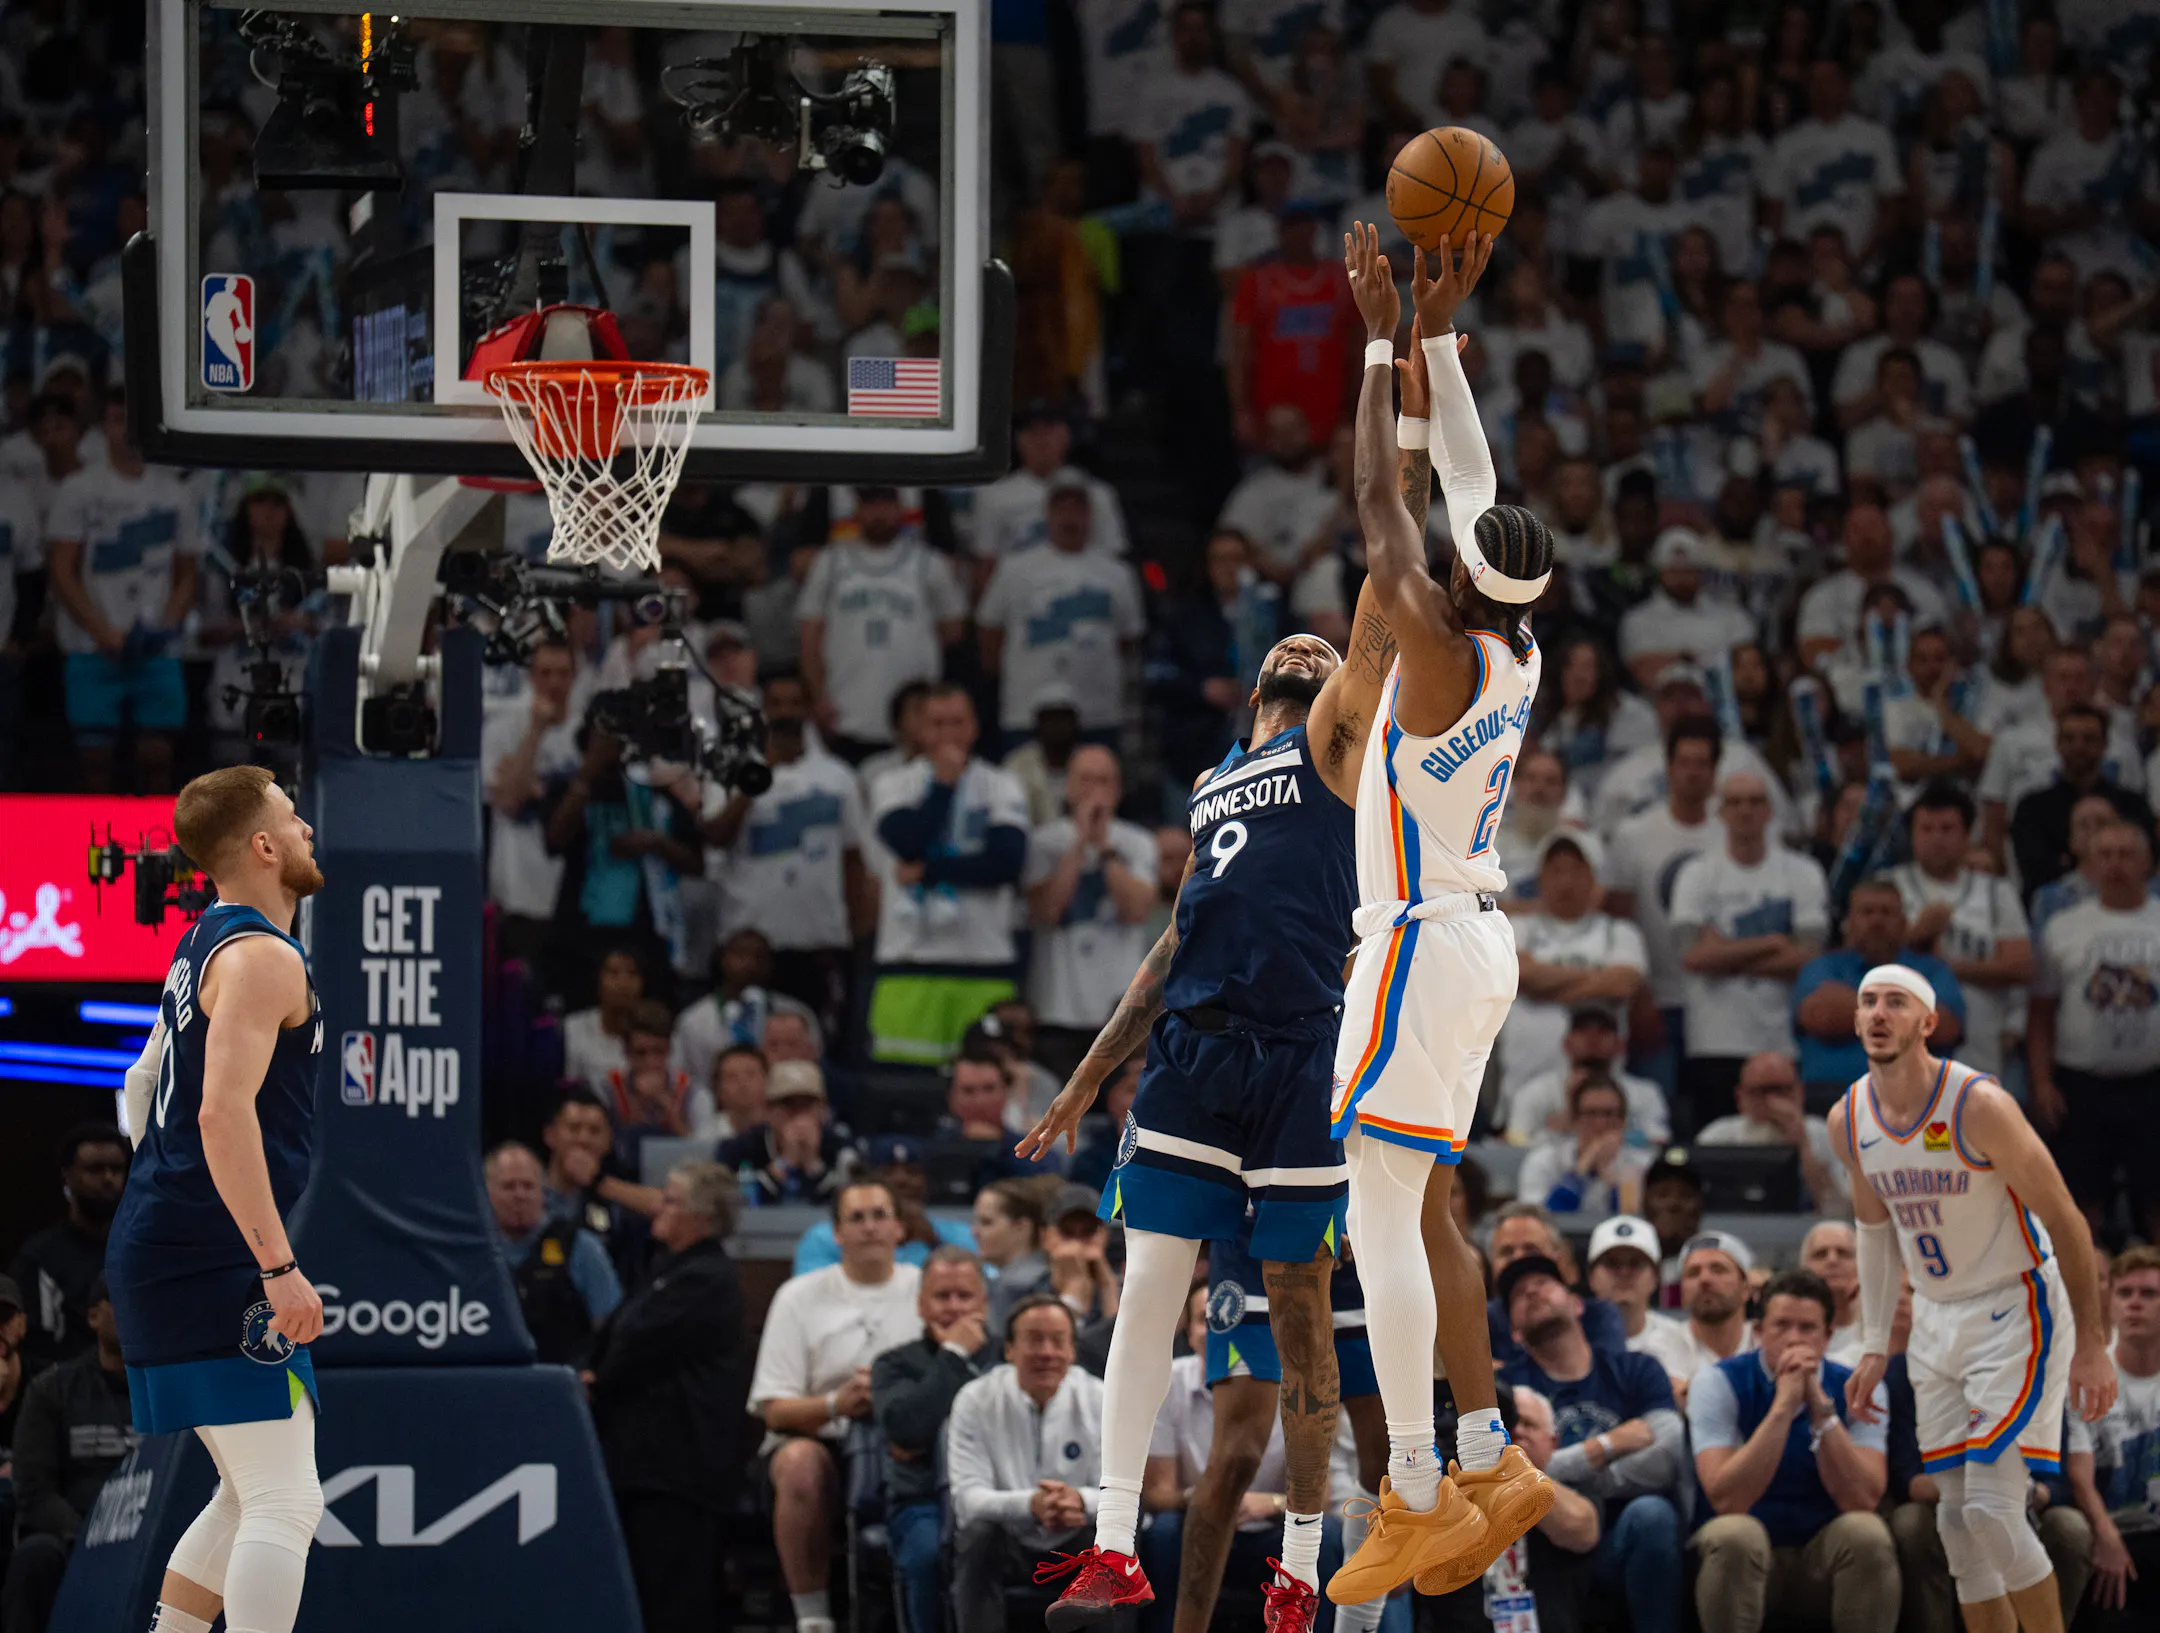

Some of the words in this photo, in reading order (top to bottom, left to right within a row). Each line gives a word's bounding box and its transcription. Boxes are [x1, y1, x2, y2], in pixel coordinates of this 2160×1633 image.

[208, 363, 235, 384] NBA
[1190, 774, 1302, 838] MINNESOTA
[1466, 754, 1513, 860] 2
[1211, 821, 1248, 879] 9
[361, 884, 442, 954] GET
[361, 958, 442, 1027] THE
[378, 1032, 460, 1119] App
[1895, 1201, 1943, 1228] CITY
[1915, 1232, 1950, 1280] 9
[313, 1283, 492, 1350] Google
